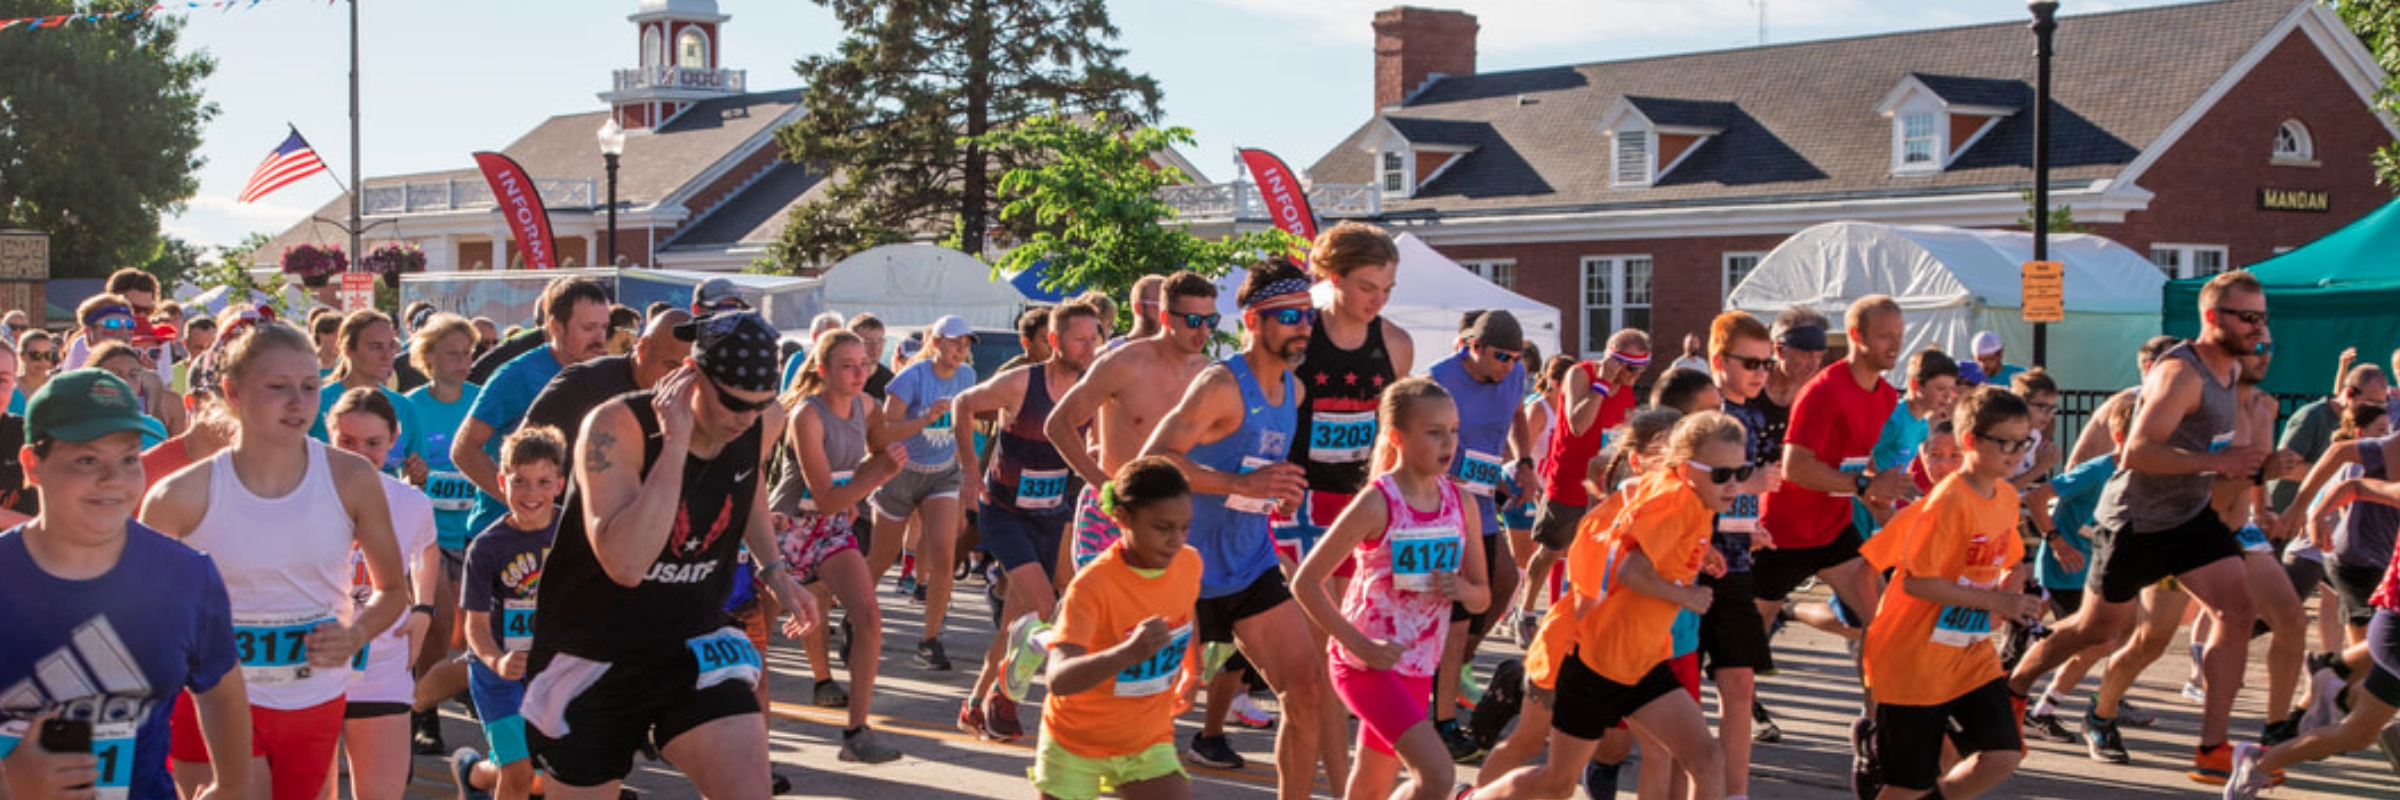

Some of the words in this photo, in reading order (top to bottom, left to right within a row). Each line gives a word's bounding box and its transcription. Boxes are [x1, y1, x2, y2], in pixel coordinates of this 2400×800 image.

[2265, 189, 2328, 209] MANDAN
[1316, 424, 1372, 447] 3203
[1398, 541, 1459, 571] 4127
